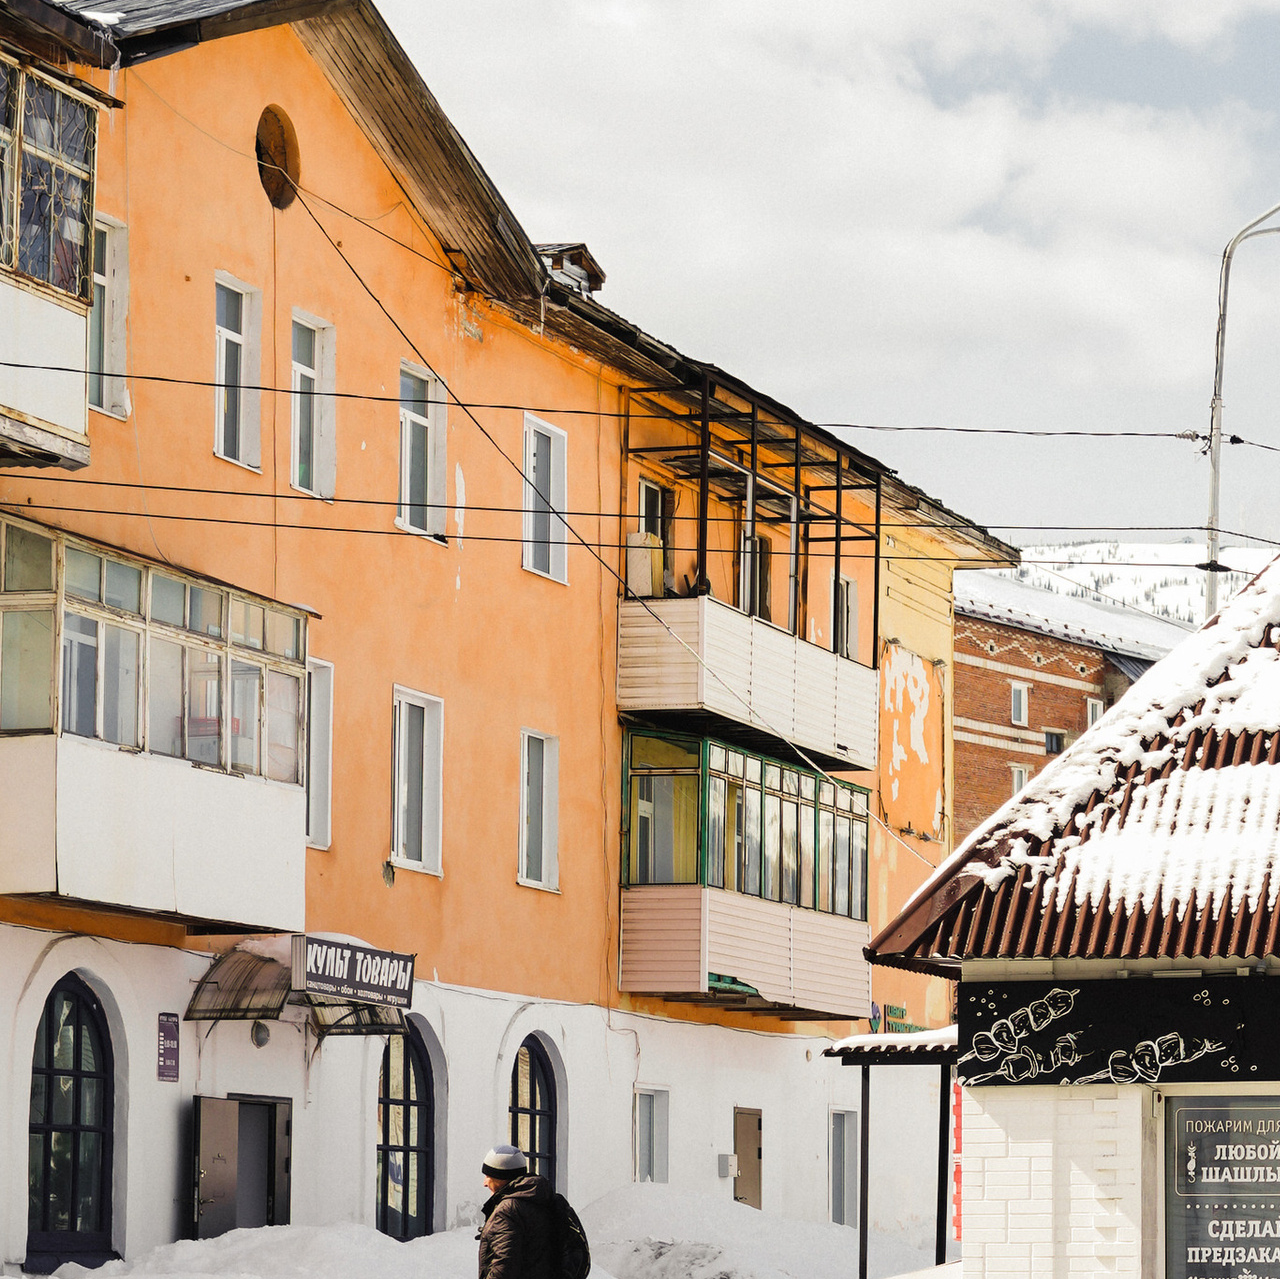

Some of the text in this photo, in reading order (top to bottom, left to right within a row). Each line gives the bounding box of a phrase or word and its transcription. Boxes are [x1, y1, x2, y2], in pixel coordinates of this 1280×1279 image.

[306, 943, 412, 990] КУЛЬТ ТОВАРЫ
[340, 984, 354, 995] обои
[1186, 1120, 1253, 1133] ПОЖАРИМ
